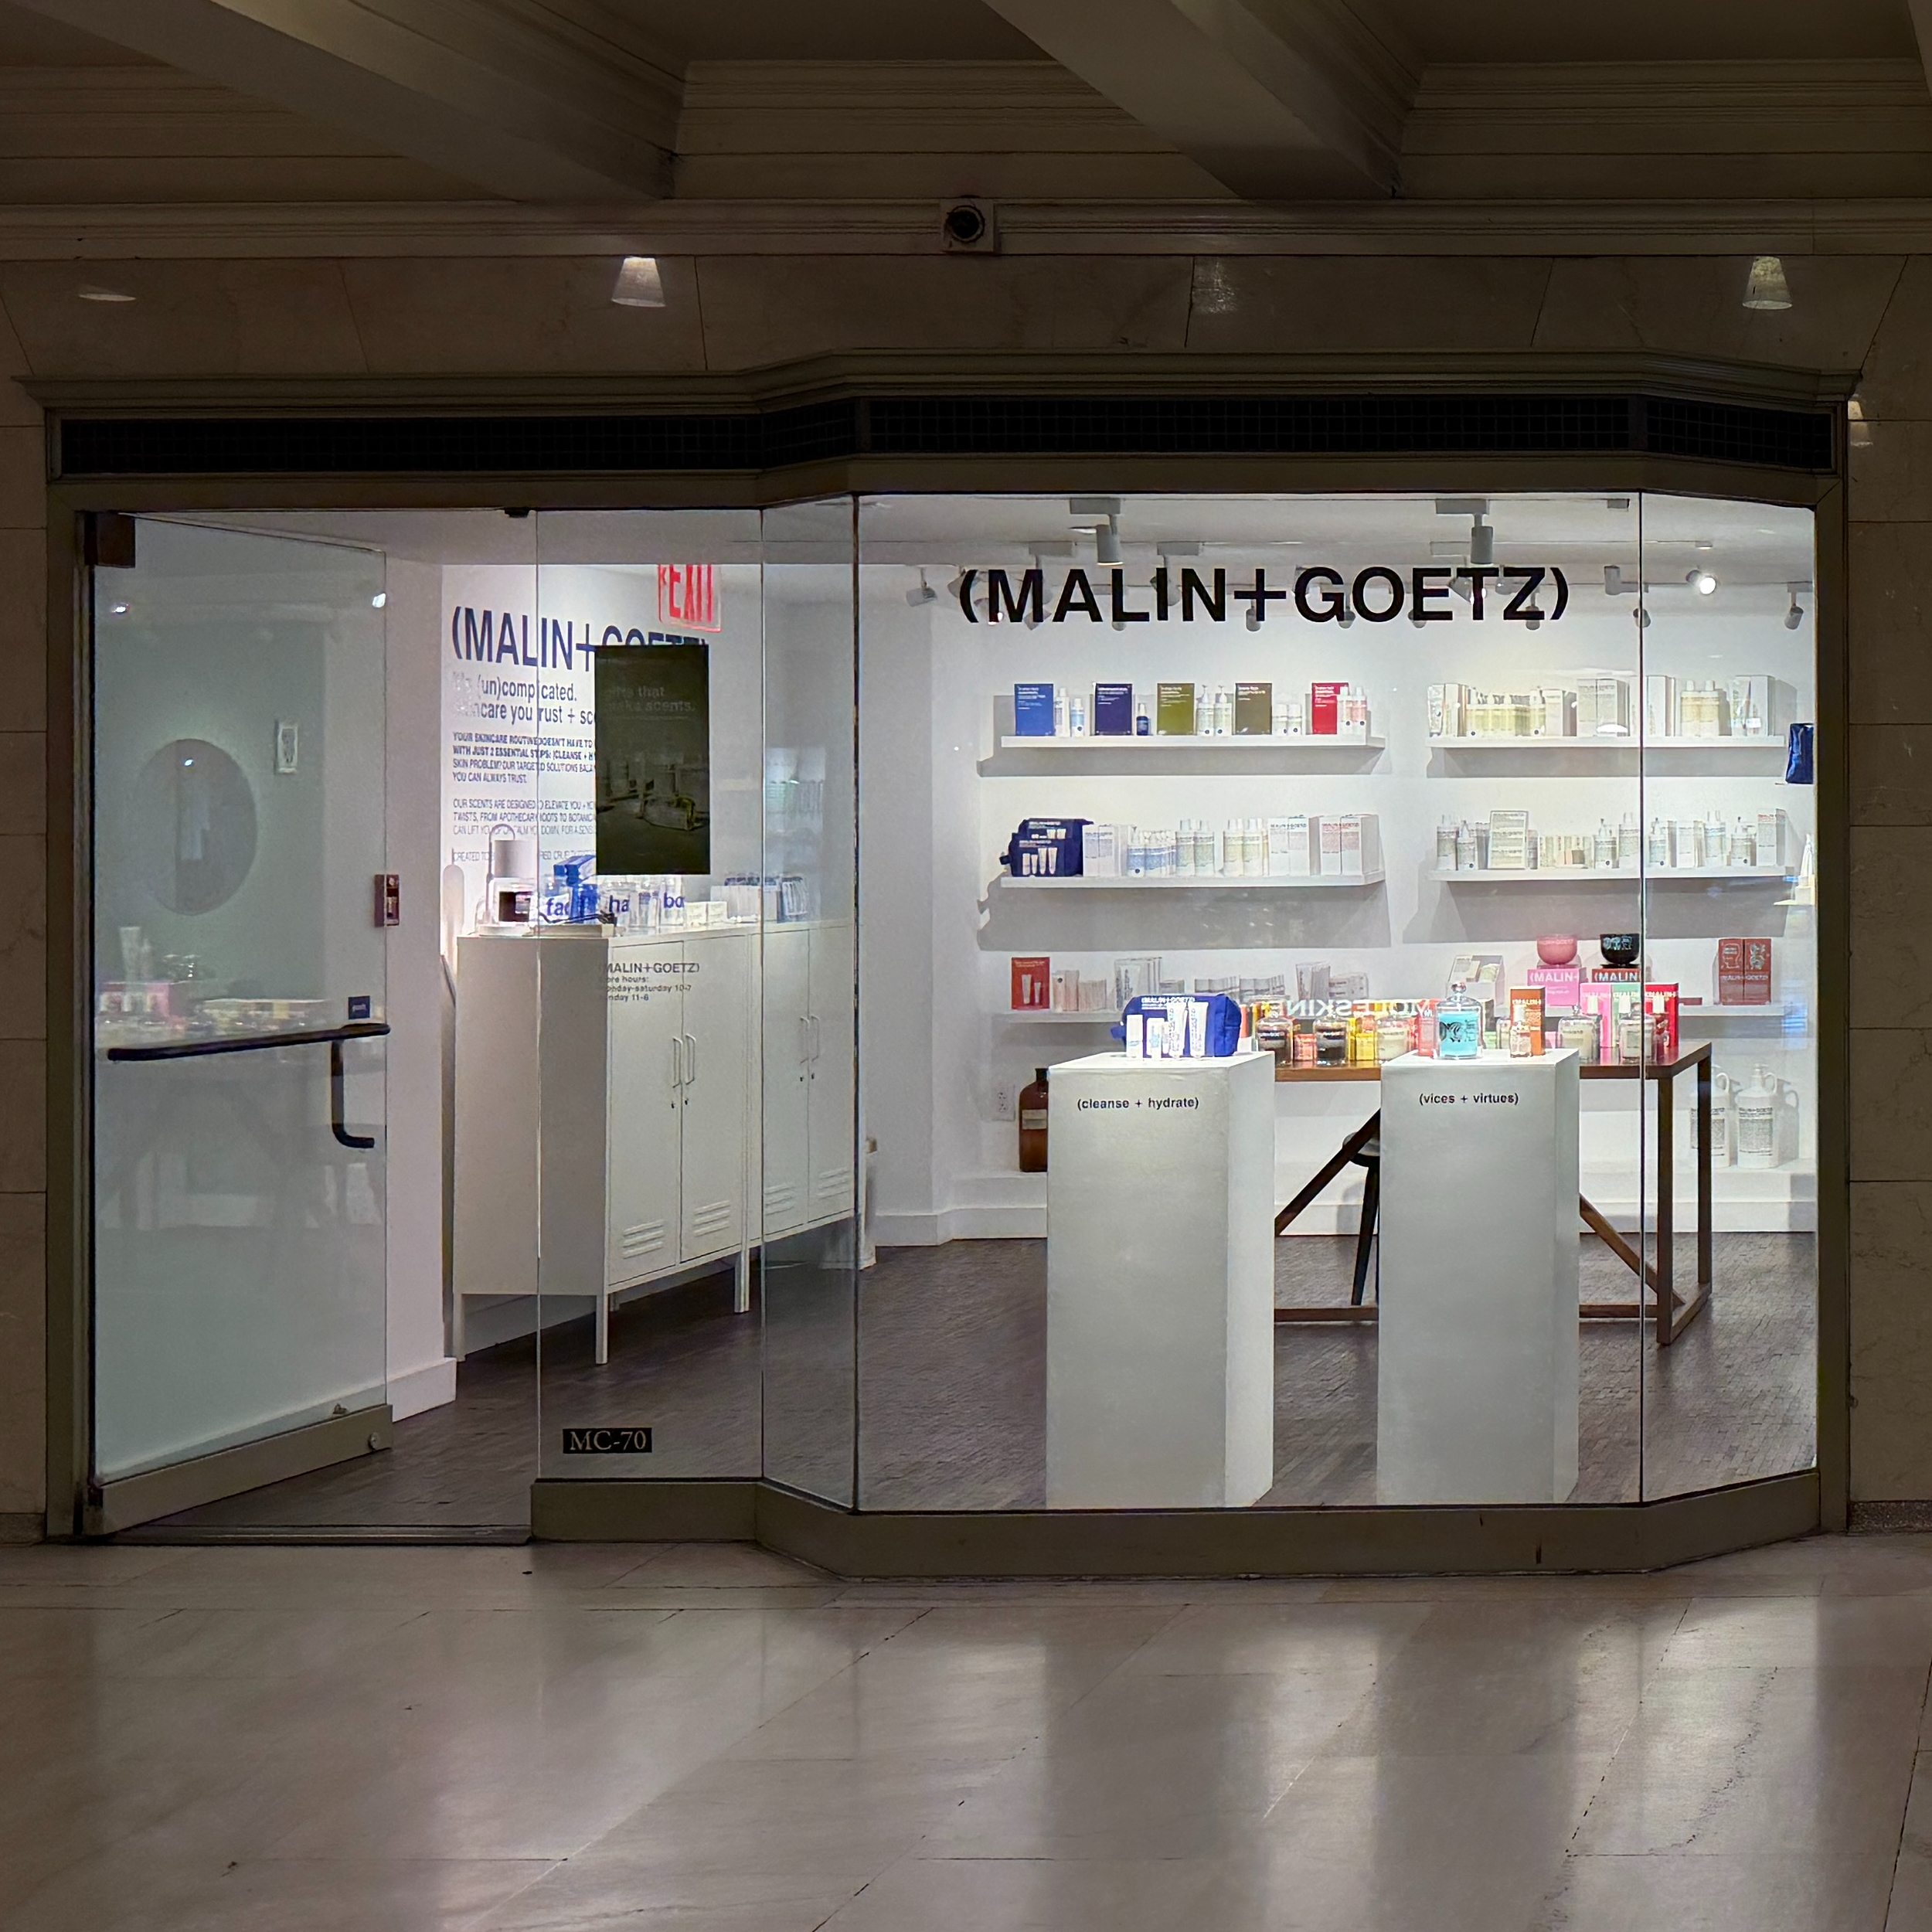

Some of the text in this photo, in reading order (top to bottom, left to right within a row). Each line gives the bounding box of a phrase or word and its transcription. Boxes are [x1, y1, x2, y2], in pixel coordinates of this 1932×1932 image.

[959, 566, 1570, 624] (MALIN+GOETZ)
[511, 706, 533, 725] you
[538, 706, 563, 723] rust
[1077, 1097, 1199, 1111] (cleanse + hydrate)
[1419, 1093, 1455, 1106] (vices
[1473, 1093, 1519, 1106] virtues)
[570, 1430, 647, 1451] MC-70
